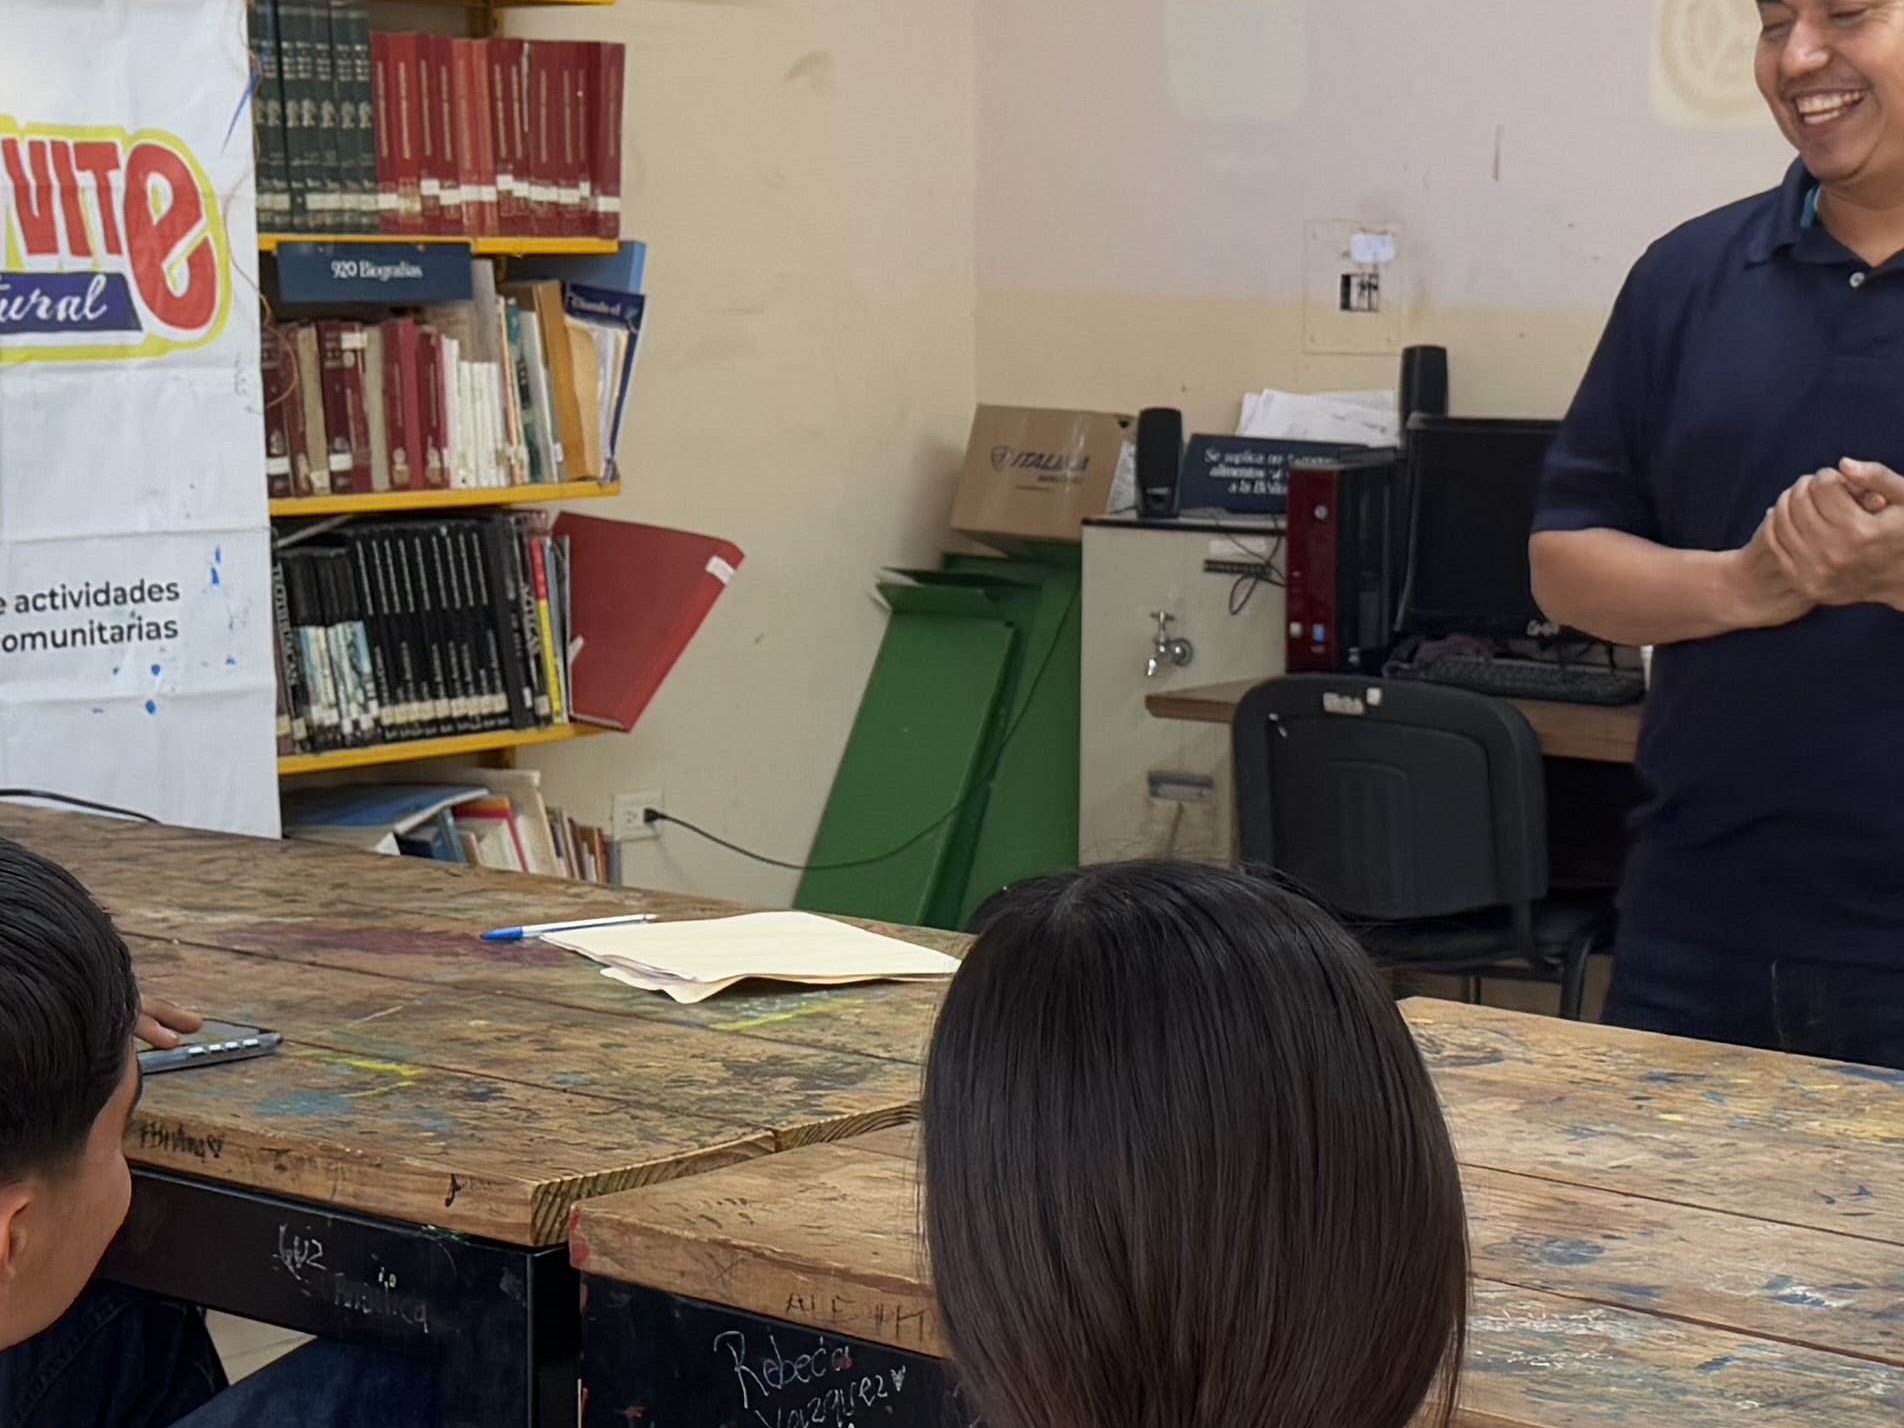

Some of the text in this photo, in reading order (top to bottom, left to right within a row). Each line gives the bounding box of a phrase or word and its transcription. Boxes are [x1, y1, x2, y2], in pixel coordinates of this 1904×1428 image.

[331, 259, 357, 279] 920
[1010, 452, 1089, 471] ITALIA
[14, 577, 181, 615] actividades
